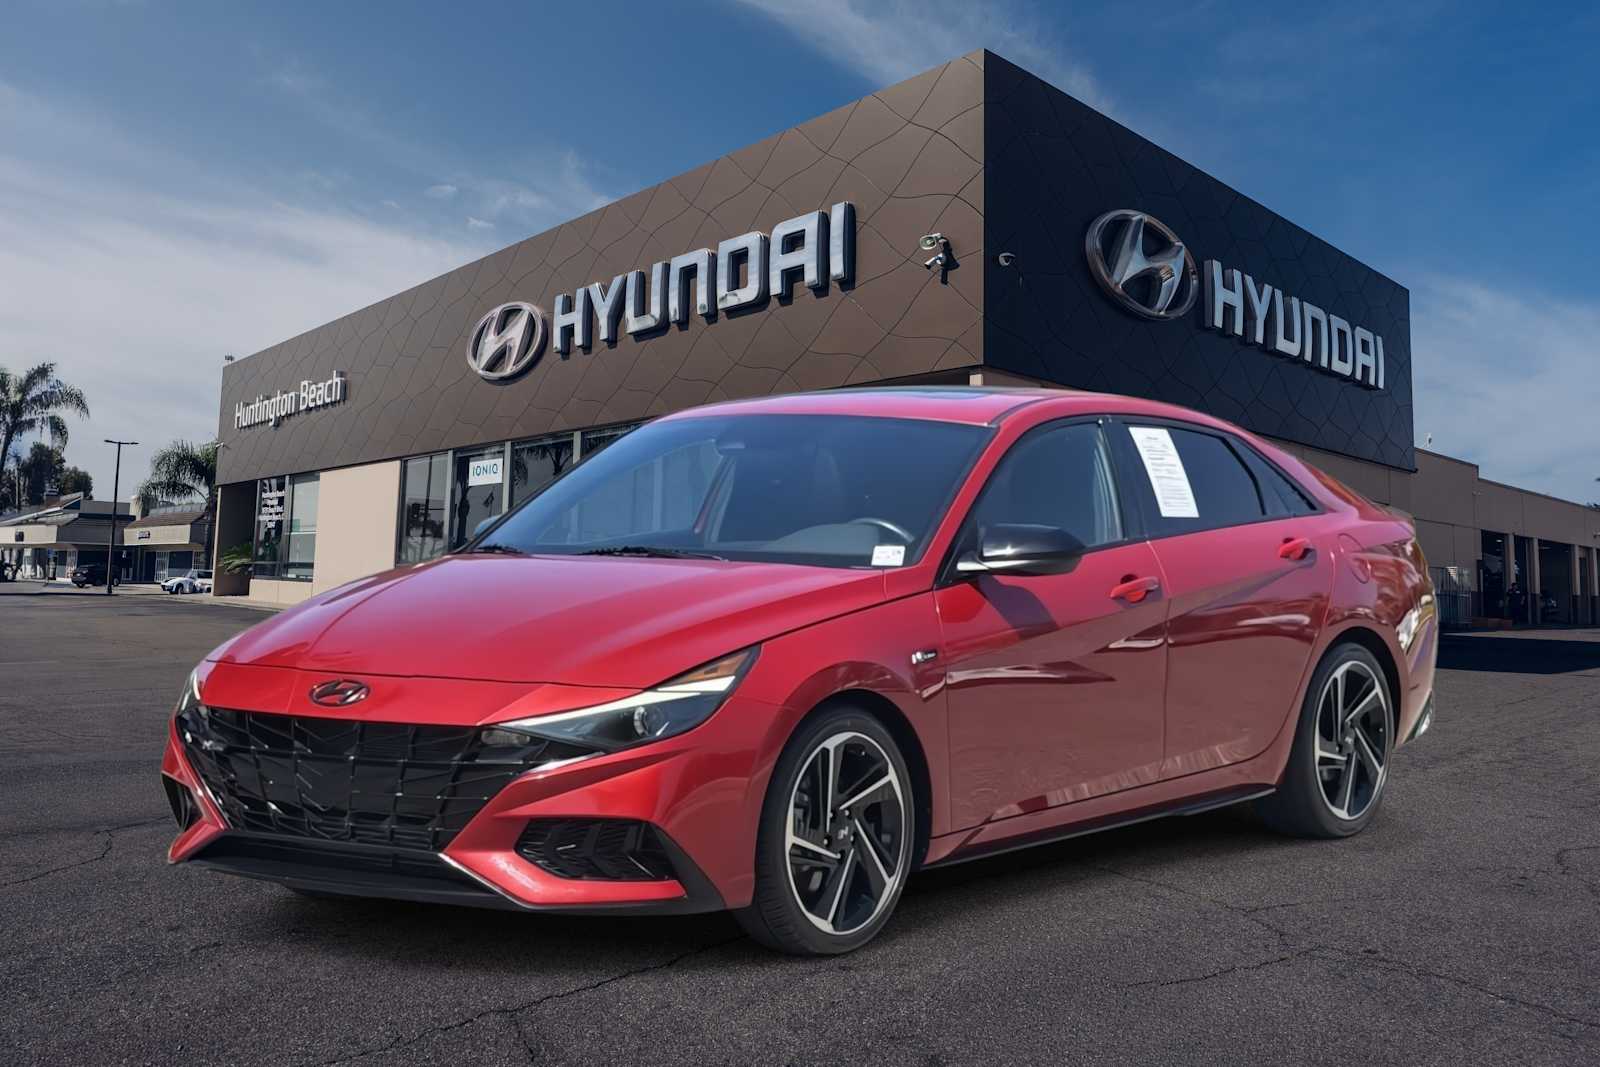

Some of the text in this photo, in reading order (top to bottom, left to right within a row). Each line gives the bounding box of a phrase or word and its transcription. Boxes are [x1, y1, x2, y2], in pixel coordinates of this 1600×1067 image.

[552, 201, 852, 354] HYUNDAI
[1205, 259, 1385, 390] HYUNDAI
[234, 370, 344, 429] Huntington Beach
